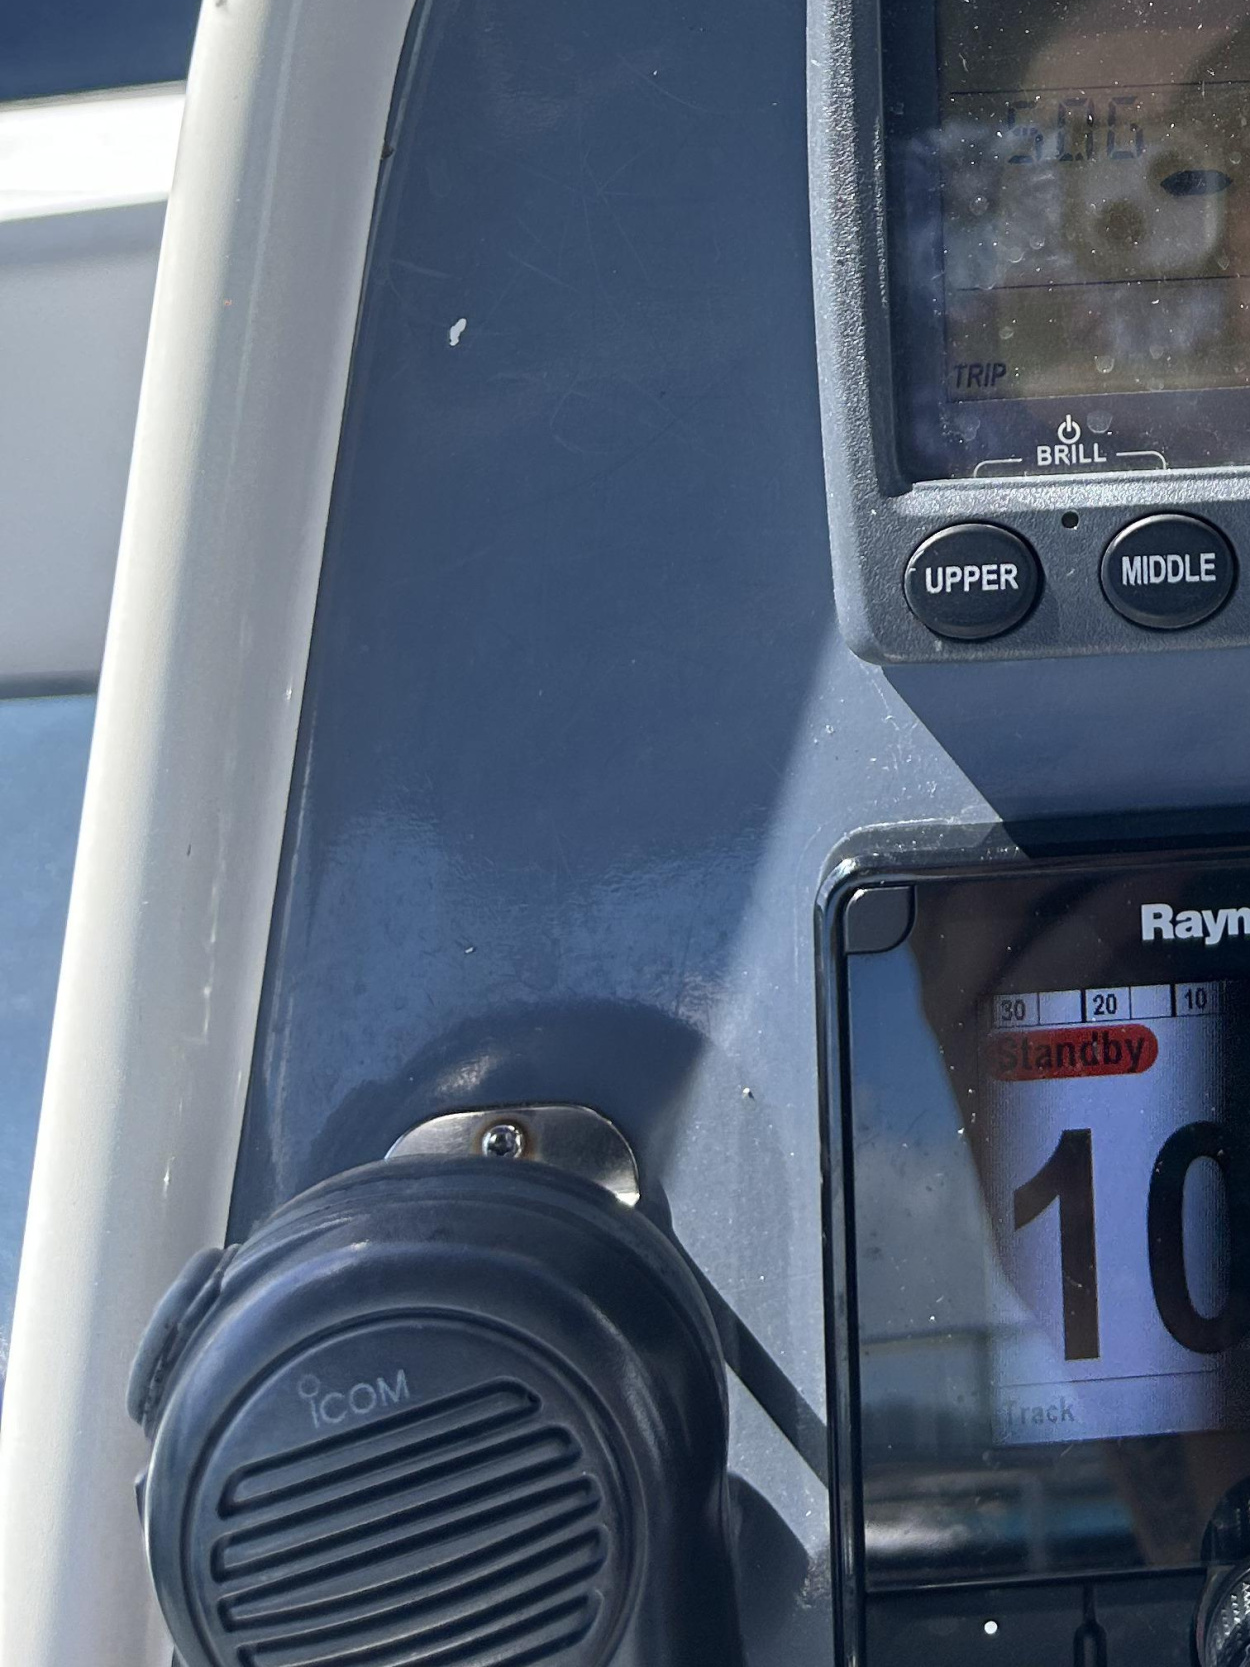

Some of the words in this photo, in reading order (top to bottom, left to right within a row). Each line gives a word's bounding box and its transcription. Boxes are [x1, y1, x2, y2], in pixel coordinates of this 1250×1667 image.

[952, 363, 1007, 390] TRIP
[1036, 445, 1107, 466] BRILL
[924, 564, 1019, 595] UPPER
[1121, 553, 1217, 586] MIDDLE
[1001, 999, 1026, 1021] 30
[1093, 994, 1117, 1016] 20
[1184, 987, 1208, 1010] 10
[1000, 1031, 1145, 1074] Standby
[1004, 1397, 1076, 1426] Track
